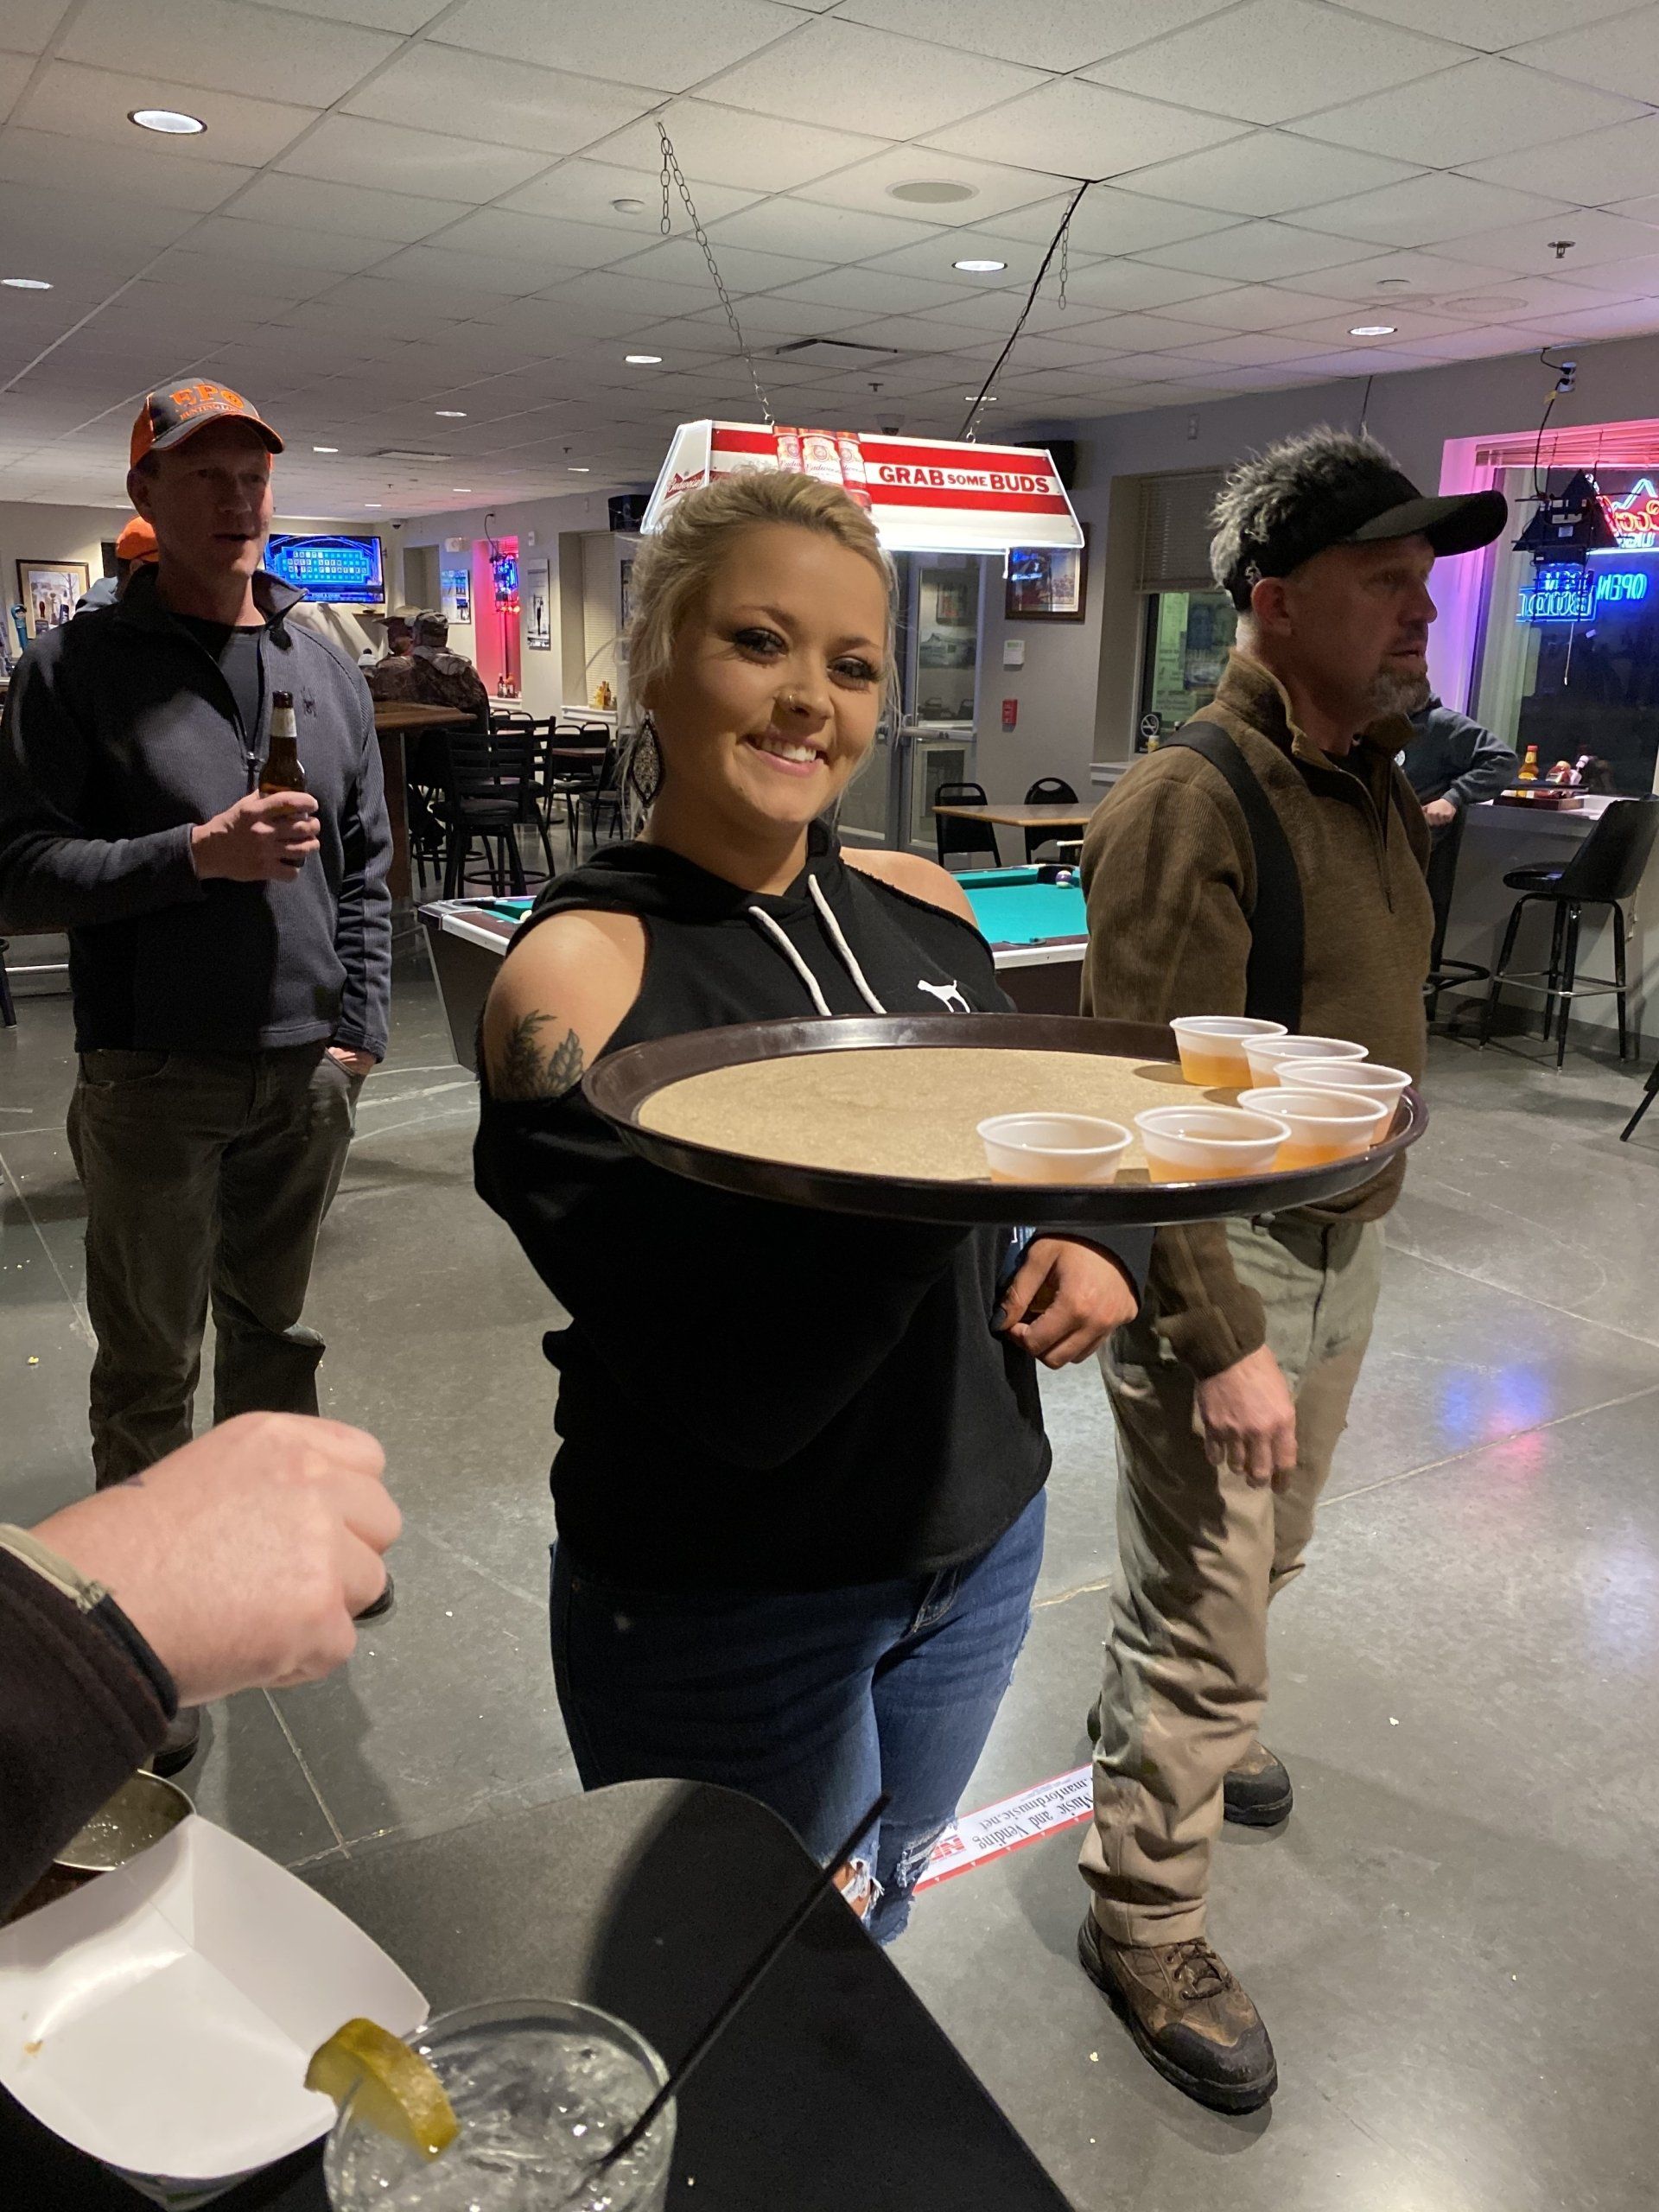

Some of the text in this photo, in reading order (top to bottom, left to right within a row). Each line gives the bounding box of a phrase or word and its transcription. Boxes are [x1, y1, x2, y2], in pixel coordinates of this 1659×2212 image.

[879, 465, 1050, 493] GRAB SOME BUDS
[972, 1793, 1093, 1850] Music and Vending
